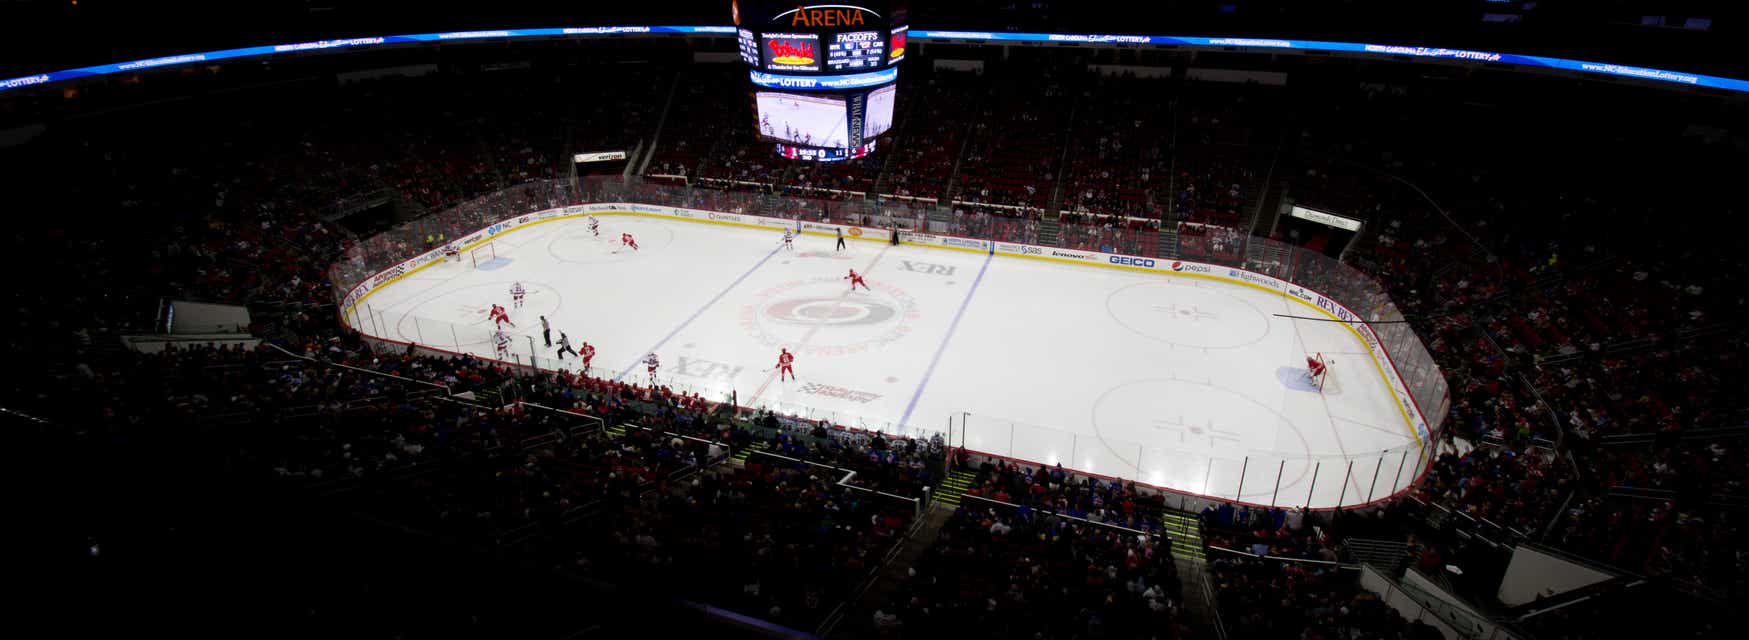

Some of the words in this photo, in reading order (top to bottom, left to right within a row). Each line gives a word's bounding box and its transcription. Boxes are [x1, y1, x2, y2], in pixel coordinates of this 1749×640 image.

[792, 5, 864, 27] ARENA
[837, 32, 878, 43] FACEOFFS
[1455, 50, 1490, 60] LOTTERY
[6, 75, 40, 88] LOTTERY
[780, 78, 817, 87] LOTTERY
[818, 149, 826, 158] 0
[1109, 255, 1155, 268] GEICO
[898, 260, 956, 276] REX
[1184, 264, 1211, 273] pepsi
[1316, 296, 1337, 315] REX
[1338, 307, 1356, 326] REX
